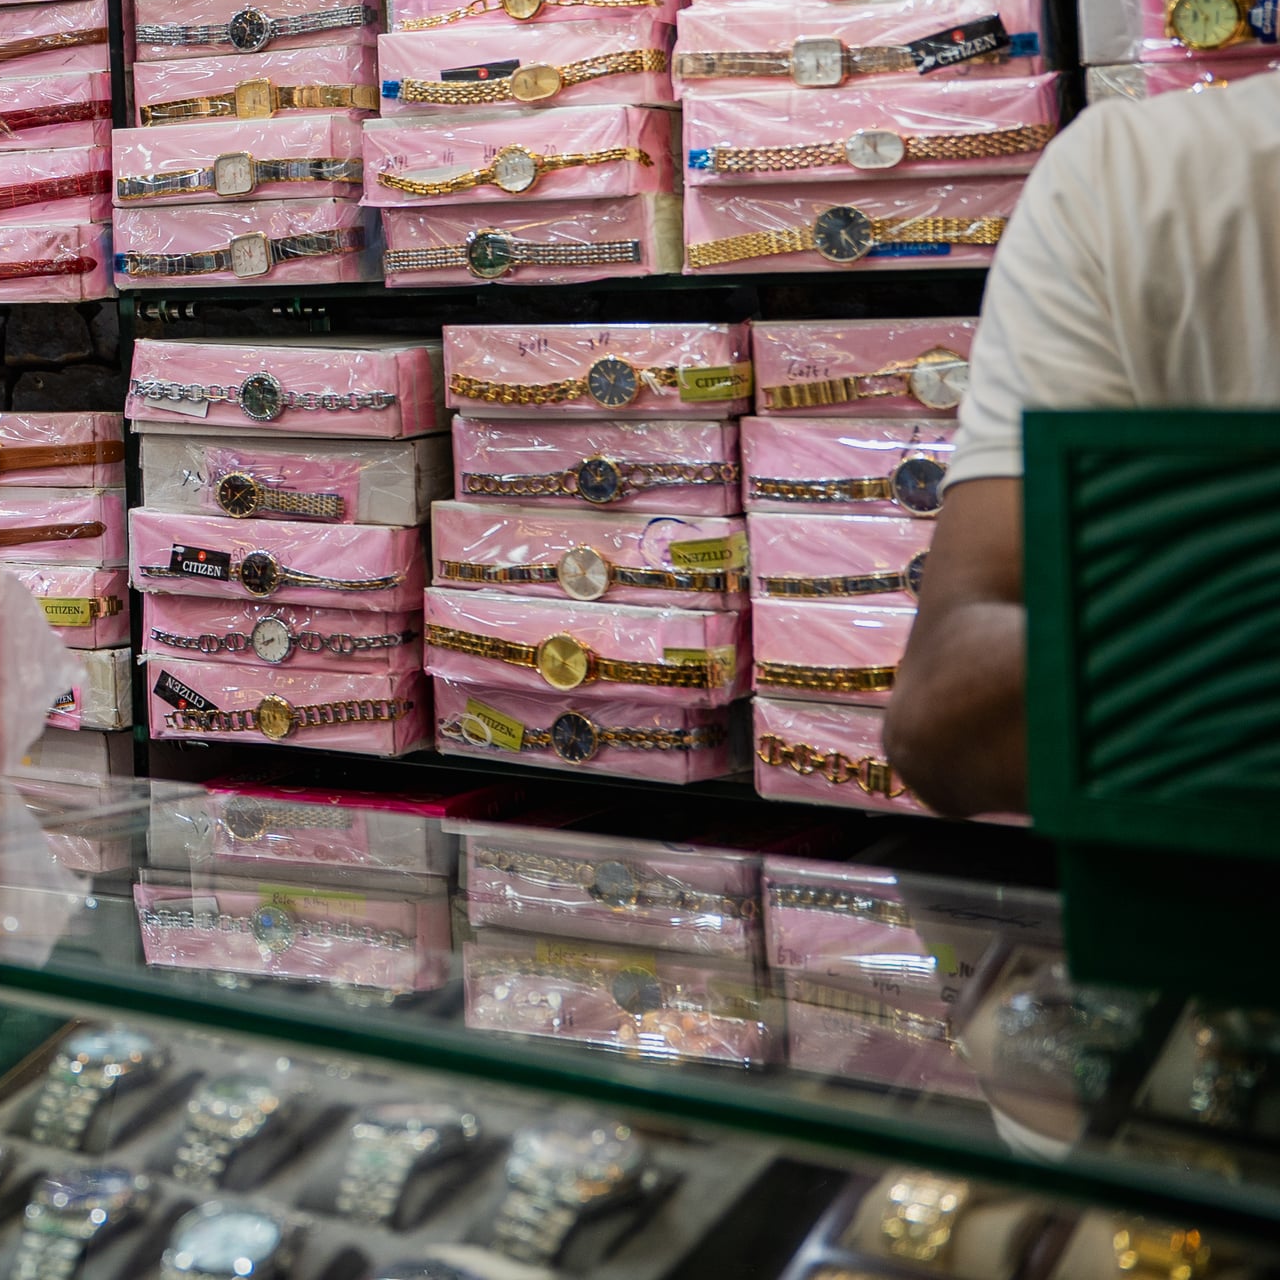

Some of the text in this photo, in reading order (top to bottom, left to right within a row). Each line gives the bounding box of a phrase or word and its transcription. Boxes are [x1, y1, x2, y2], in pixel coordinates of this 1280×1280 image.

[936, 32, 997, 65] CITIZEN
[182, 560, 222, 578] CITIZEN
[44, 605, 84, 615] CITIZEN
[165, 677, 206, 709] CITIZEN
